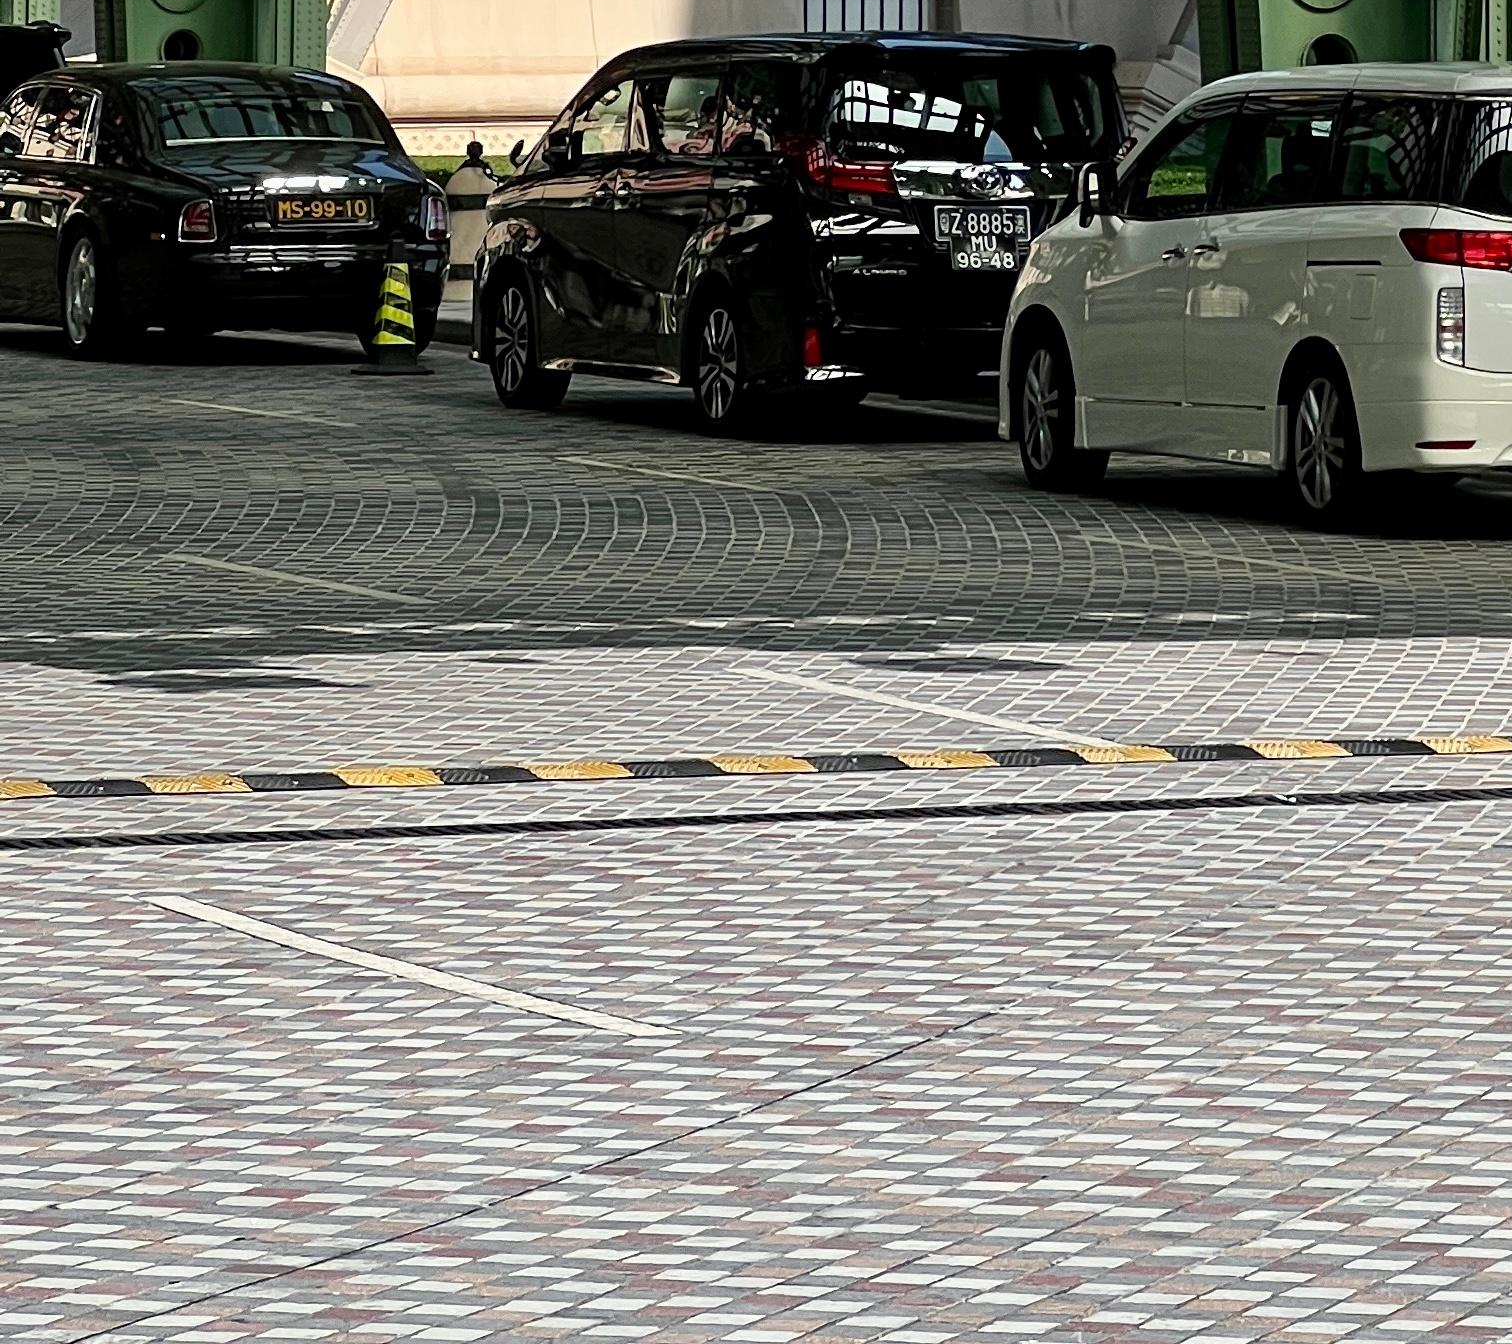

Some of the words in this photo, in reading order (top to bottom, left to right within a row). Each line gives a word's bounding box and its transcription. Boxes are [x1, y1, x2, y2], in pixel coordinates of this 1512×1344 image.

[278, 200, 367, 219] MS-99-10
[971, 236, 997, 251] MU
[957, 252, 1015, 269] 96-48
